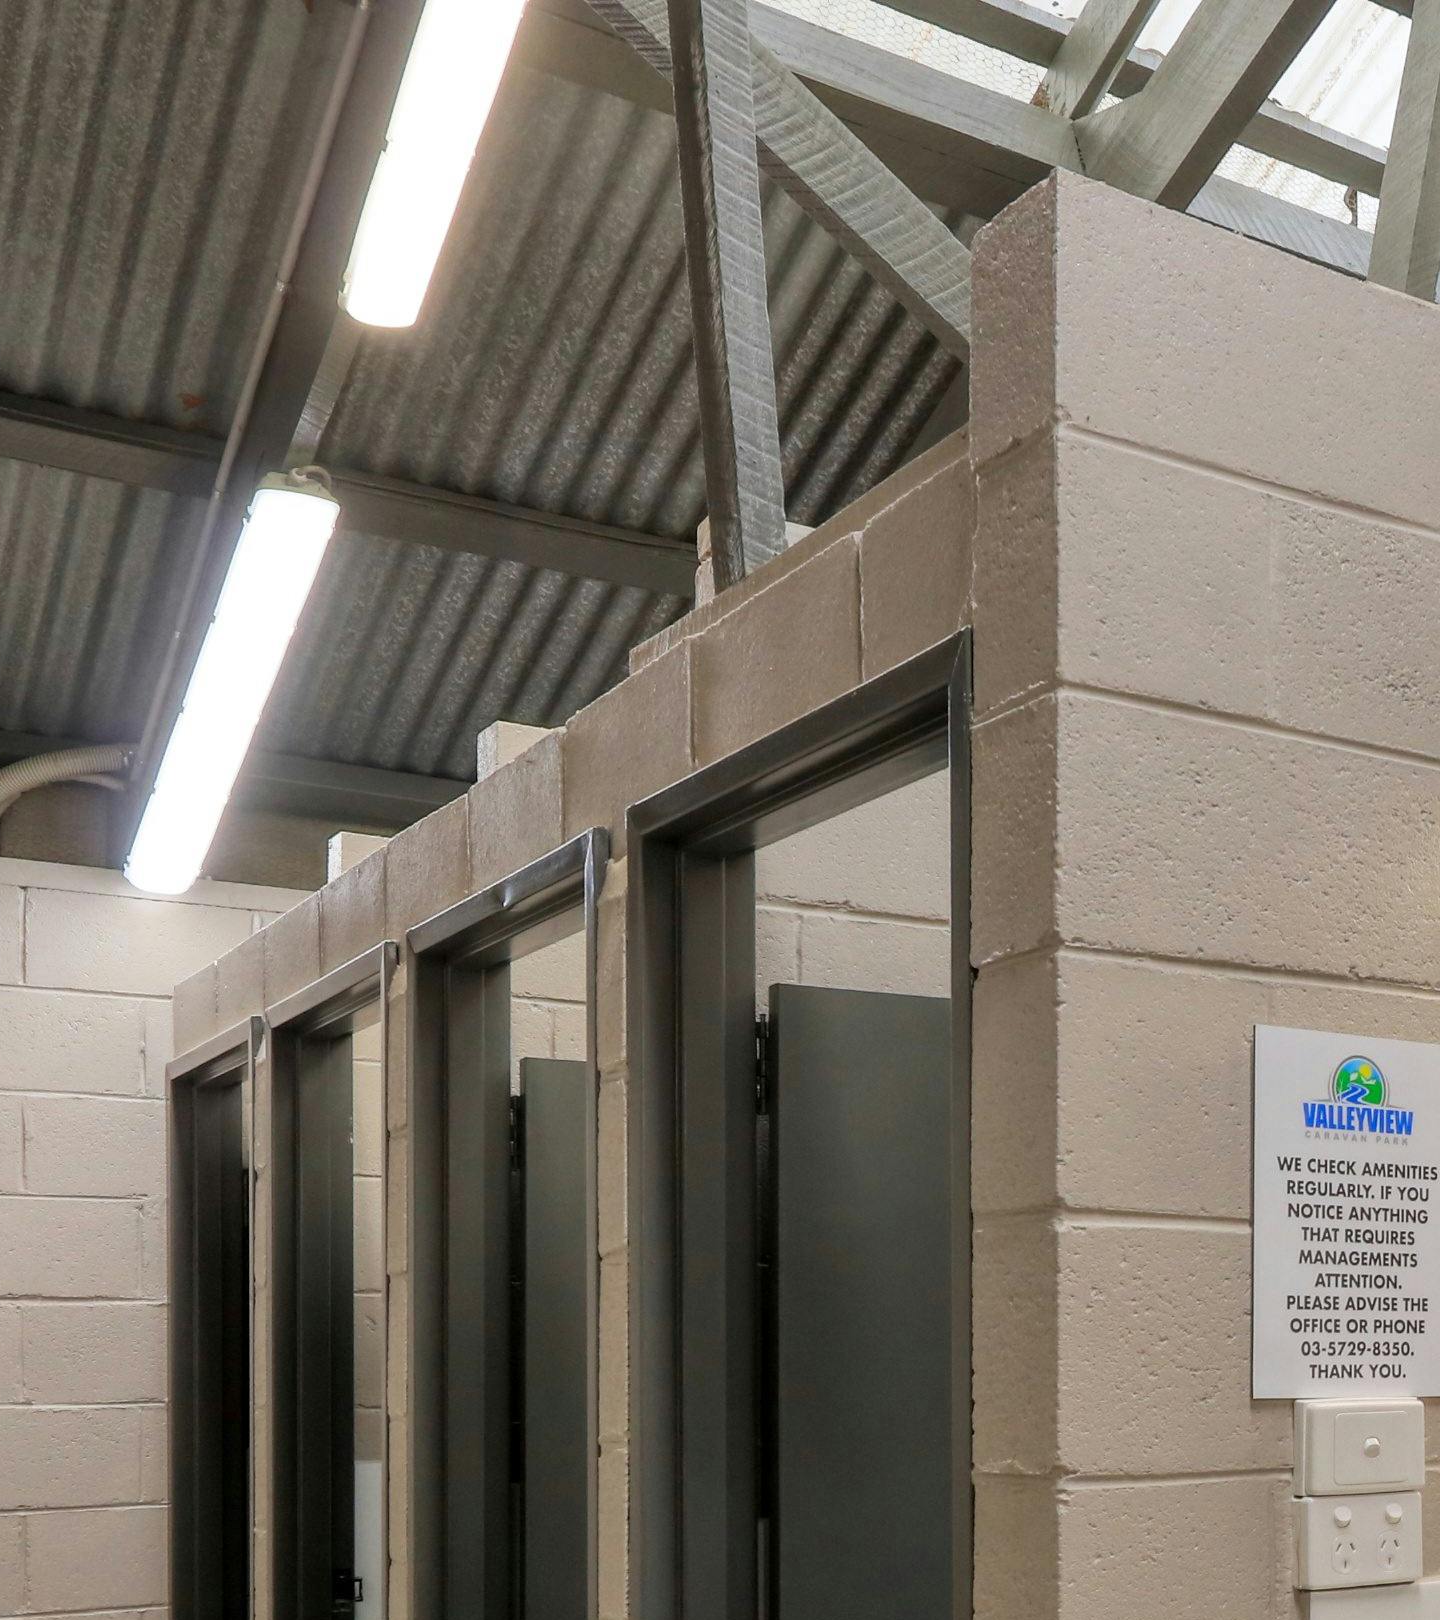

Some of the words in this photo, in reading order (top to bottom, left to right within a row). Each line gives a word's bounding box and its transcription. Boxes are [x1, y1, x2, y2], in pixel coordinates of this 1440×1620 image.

[1303, 1102, 1414, 1136] VALLEYVIEW
[1304, 1130, 1368, 1144] CARAVAN
[1376, 1136, 1409, 1146] PARK
[1277, 1156, 1302, 1173] WE
[1307, 1158, 1357, 1176] CHECK
[1362, 1162, 1438, 1181] AMENITIES
[1286, 1180, 1375, 1199] REGULARLY.
[1380, 1185, 1392, 1200] IF
[1397, 1186, 1430, 1202] YOU
[1287, 1203, 1343, 1220] NOTICE
[1348, 1206, 1429, 1224] ANYTHING
[1301, 1226, 1339, 1243] THAT
[1344, 1228, 1415, 1245] REQUIRES
[1298, 1250, 1418, 1268] MANAGEMENTS
[1314, 1273, 1403, 1290] ATTENTION.
[1286, 1295, 1340, 1311] PLEASE
[1345, 1296, 1398, 1312] ADVISE
[1402, 1298, 1429, 1312] THE
[1289, 1318, 1341, 1334] OFFICE
[1346, 1319, 1368, 1334] OR
[1373, 1319, 1426, 1334] PHONE
[1301, 1341, 1415, 1357] 03-5729-8350.
[1309, 1364, 1364, 1379] THANK
[1368, 1364, 1407, 1379] YOU.
